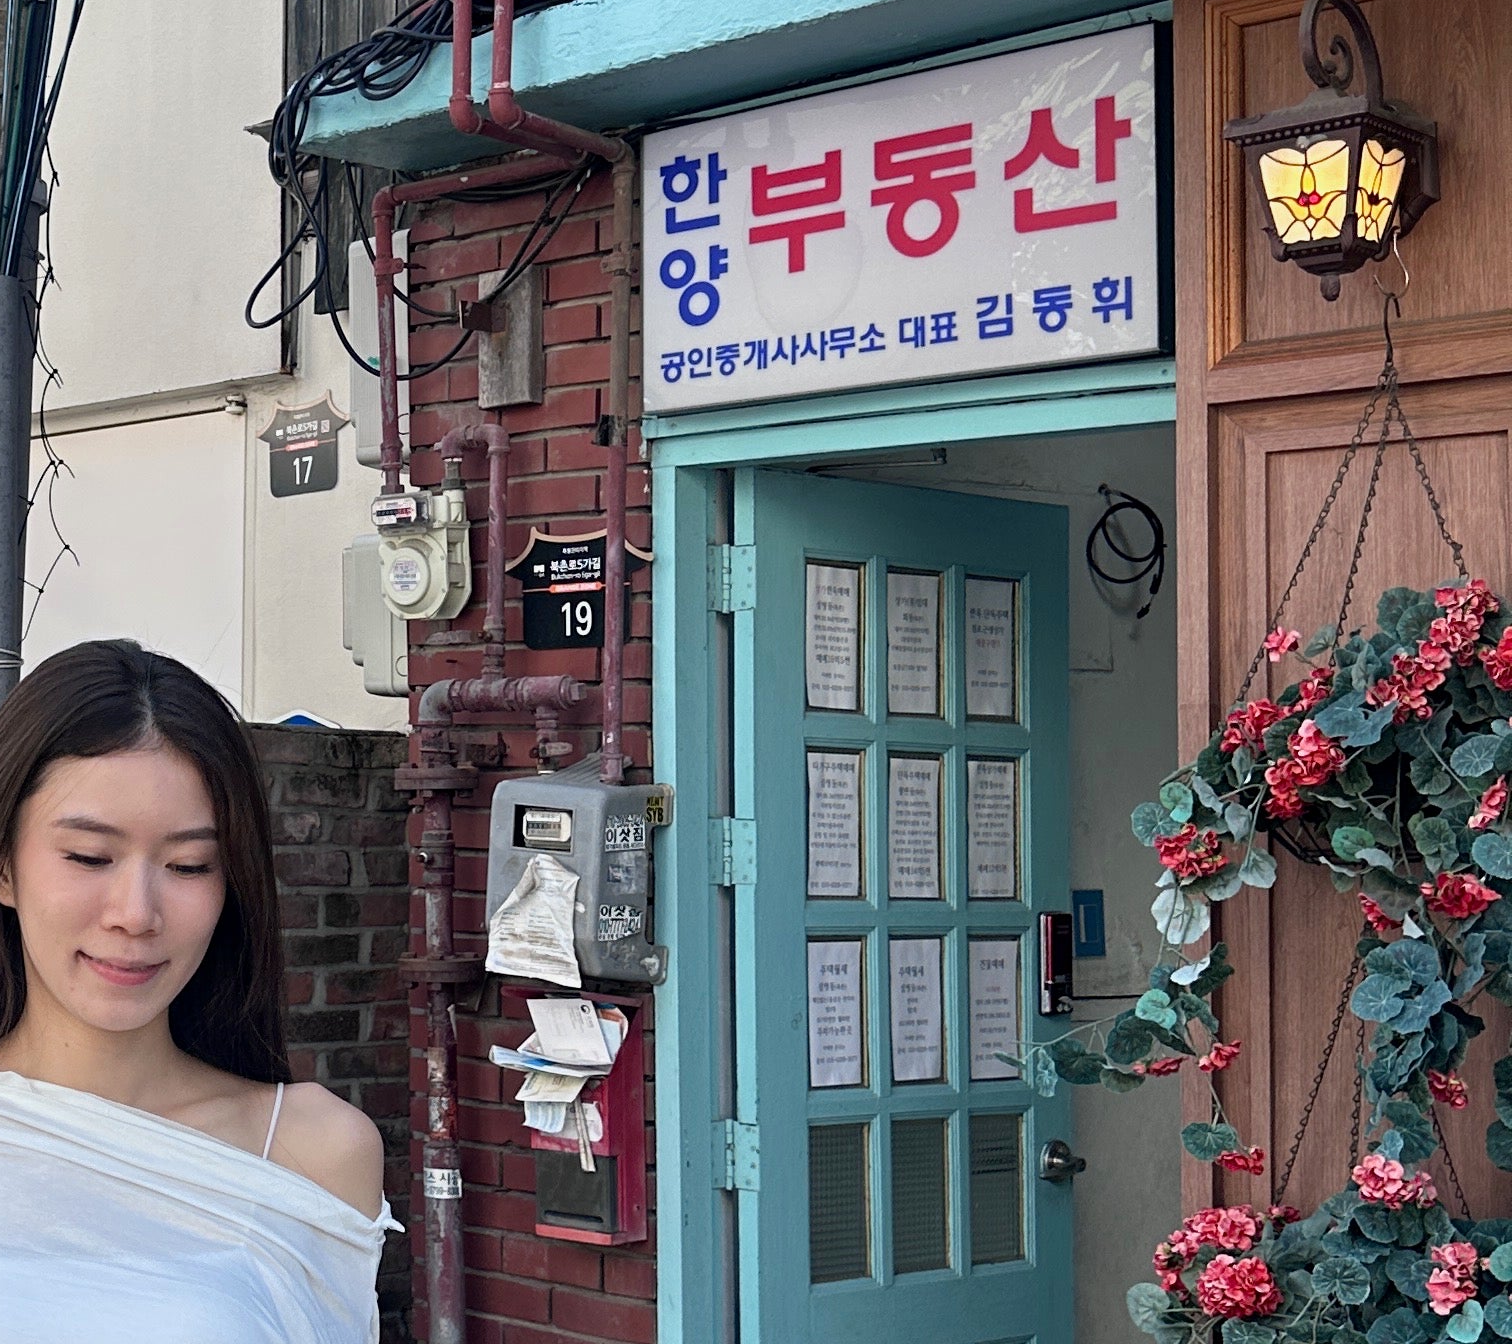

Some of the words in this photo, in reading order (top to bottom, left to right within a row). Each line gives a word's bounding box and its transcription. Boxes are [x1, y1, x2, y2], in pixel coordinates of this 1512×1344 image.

[658, 151, 730, 328] 한양
[747, 95, 1134, 275] 부동산
[659, 321, 887, 384] 공인중개사사무소
[898, 310, 958, 349] 대표
[974, 275, 1135, 341] 김동휘
[292, 455, 313, 486] 17
[550, 556, 602, 573] 북촌로5가길
[561, 600, 593, 637] 19
[605, 827, 644, 844] 이삿짐
